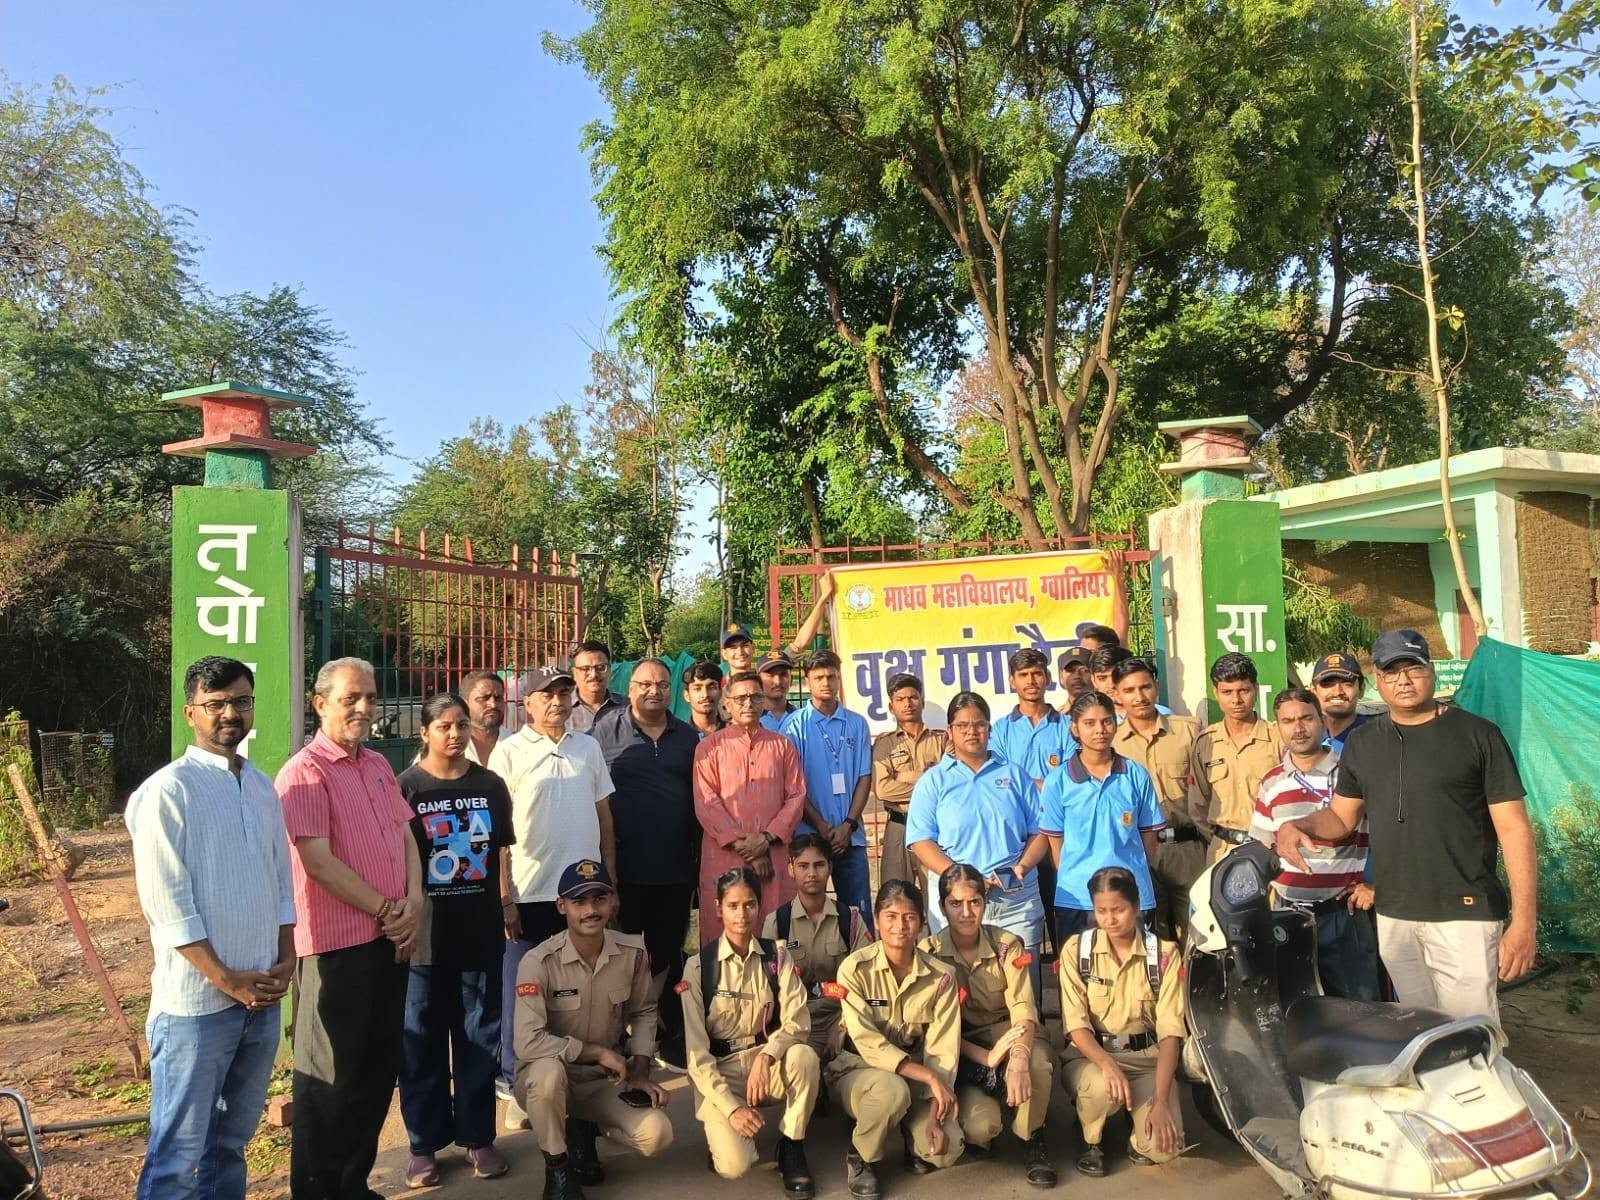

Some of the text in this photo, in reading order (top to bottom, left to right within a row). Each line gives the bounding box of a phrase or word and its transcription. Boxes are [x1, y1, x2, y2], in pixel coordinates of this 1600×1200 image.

[883, 585, 927, 612] माधव
[932, 574, 1036, 609] महाविद्यालय,
[1040, 566, 1111, 601] ग्वालियर
[936, 627, 1020, 695] गंगा
[417, 797, 488, 814] GAME OVER
[518, 985, 536, 994] NCC
